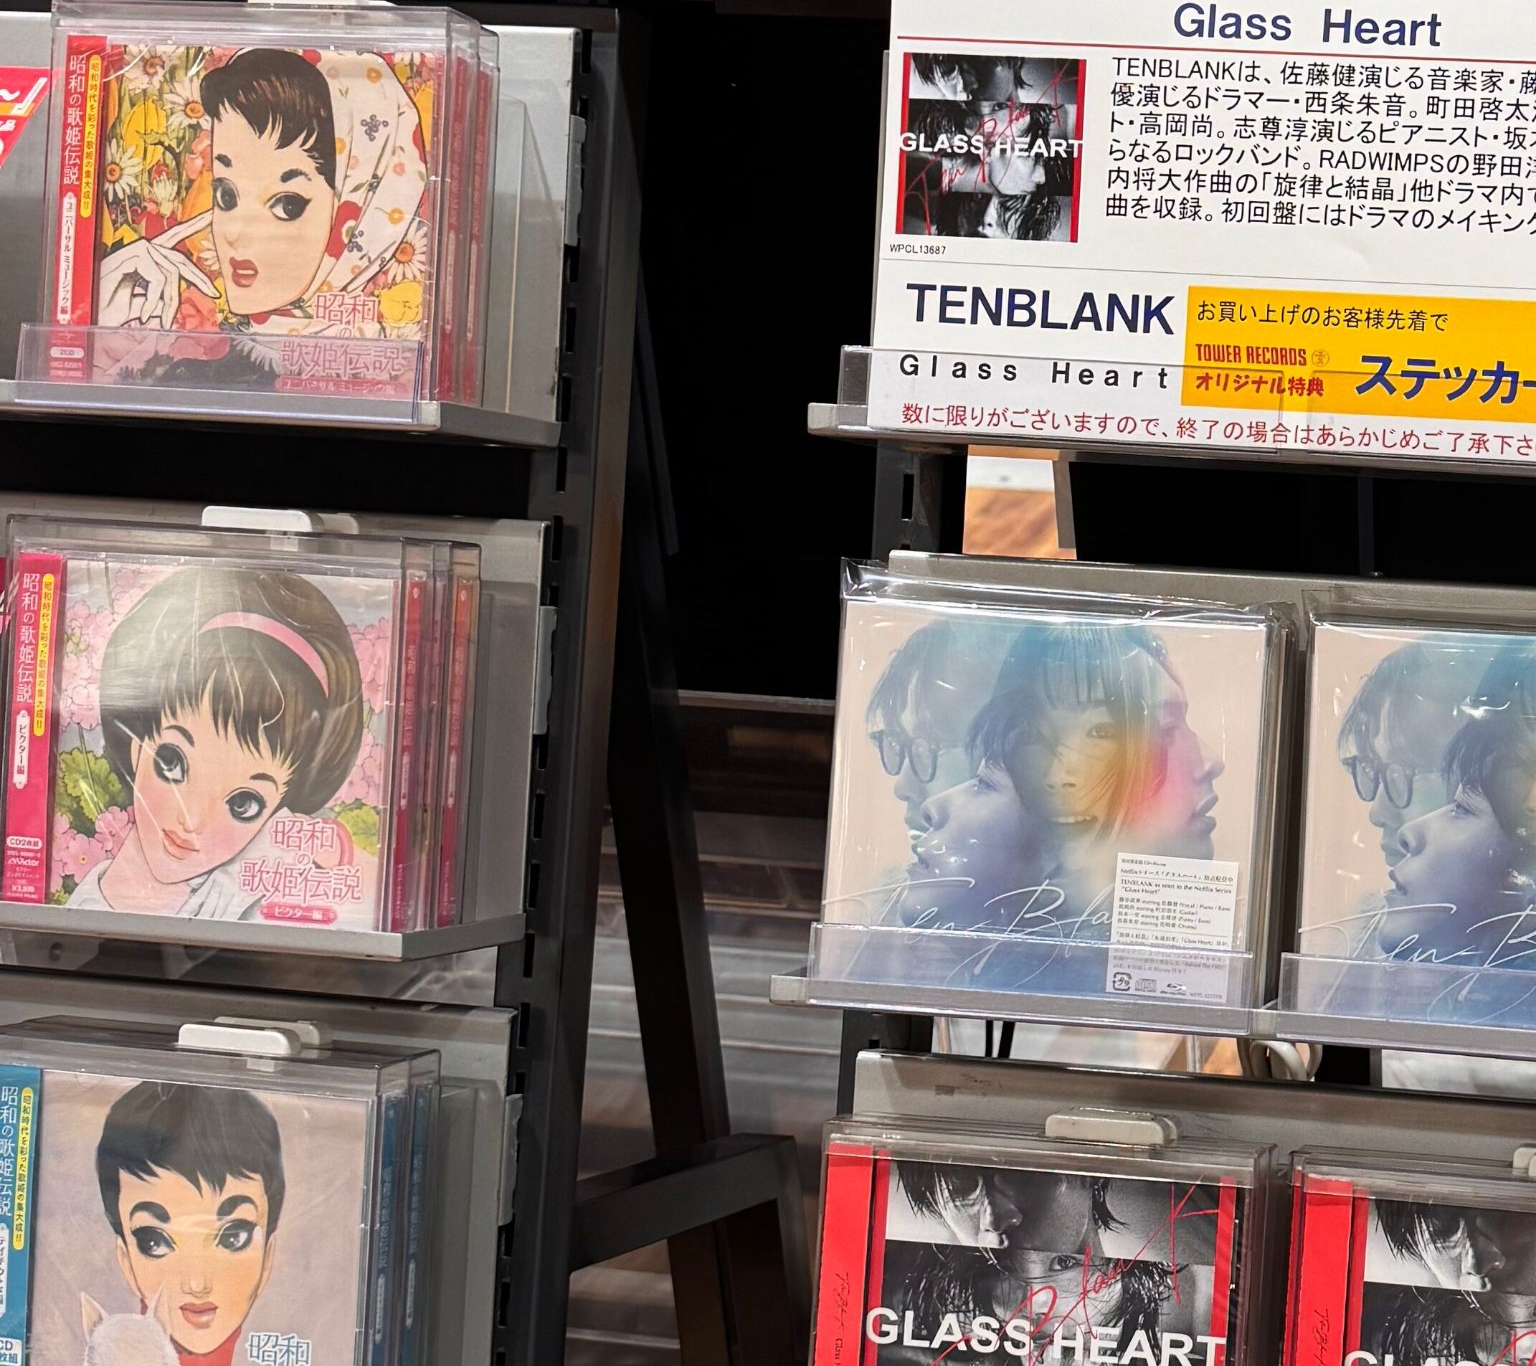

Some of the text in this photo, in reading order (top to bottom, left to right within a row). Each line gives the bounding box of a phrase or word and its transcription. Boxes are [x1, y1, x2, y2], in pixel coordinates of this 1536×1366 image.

[1173, 3, 1442, 49] Glass Heart
[900, 132, 1084, 158] GLASS HEART
[888, 243, 946, 256] WPCL13687
[314, 293, 378, 325] 昭和
[907, 284, 1175, 336] TENBLANK
[1196, 299, 1449, 334] お買い上げのお客様先着で
[899, 354, 1168, 389] Glass Heart
[1195, 344, 1307, 366] TOWER RECORDS
[16, 572, 40, 703] 昭和の歌姫伝説
[272, 817, 336, 850] 昭和
[240, 861, 362, 903] 歌姫伝説
[248, 1333, 312, 1366] 昭和
[866, 1307, 1035, 1358] GLASS
